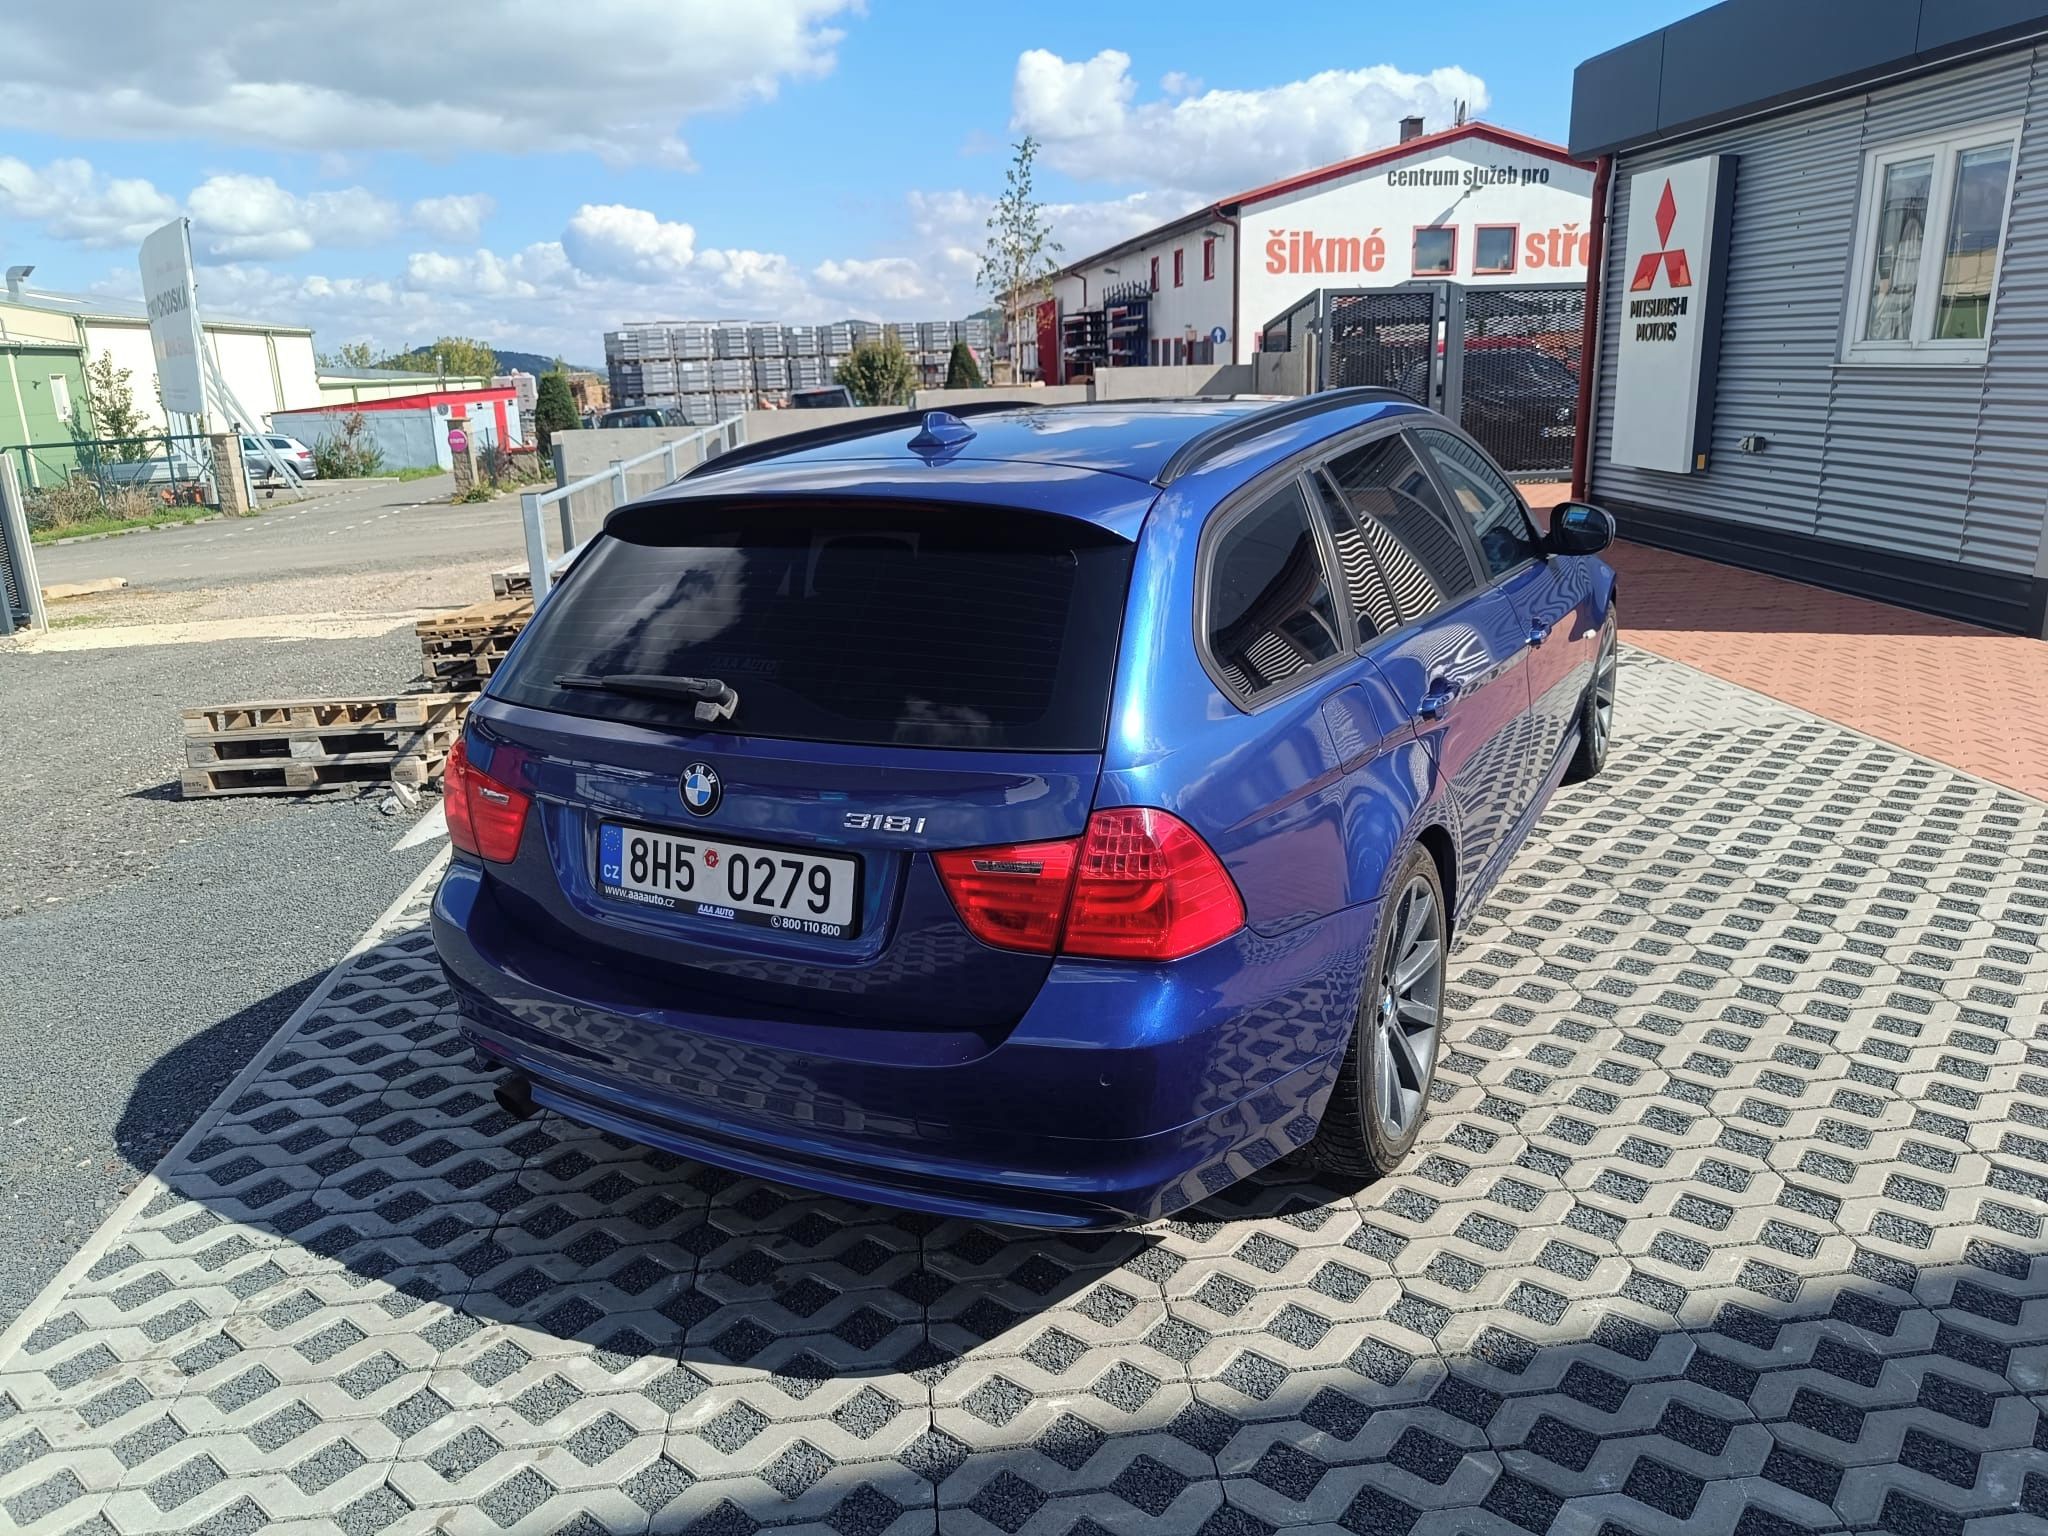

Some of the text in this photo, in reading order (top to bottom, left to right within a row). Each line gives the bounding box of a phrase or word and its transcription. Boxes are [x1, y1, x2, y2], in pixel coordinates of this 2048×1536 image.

[1388, 165, 1549, 186] centrum služeb pro
[1265, 227, 1386, 274] šikmé
[1630, 296, 1688, 318] MITSUBISHI
[1636, 322, 1677, 341] MOTORS
[684, 765, 716, 784] BMW
[843, 812, 926, 834] 318i
[603, 863, 620, 880] CZ
[630, 837, 831, 915] 8H5 0279
[604, 885, 676, 908] www.aaaauto.cz
[698, 903, 735, 918] AAA AUTO
[782, 917, 840, 936] 800 110 800
